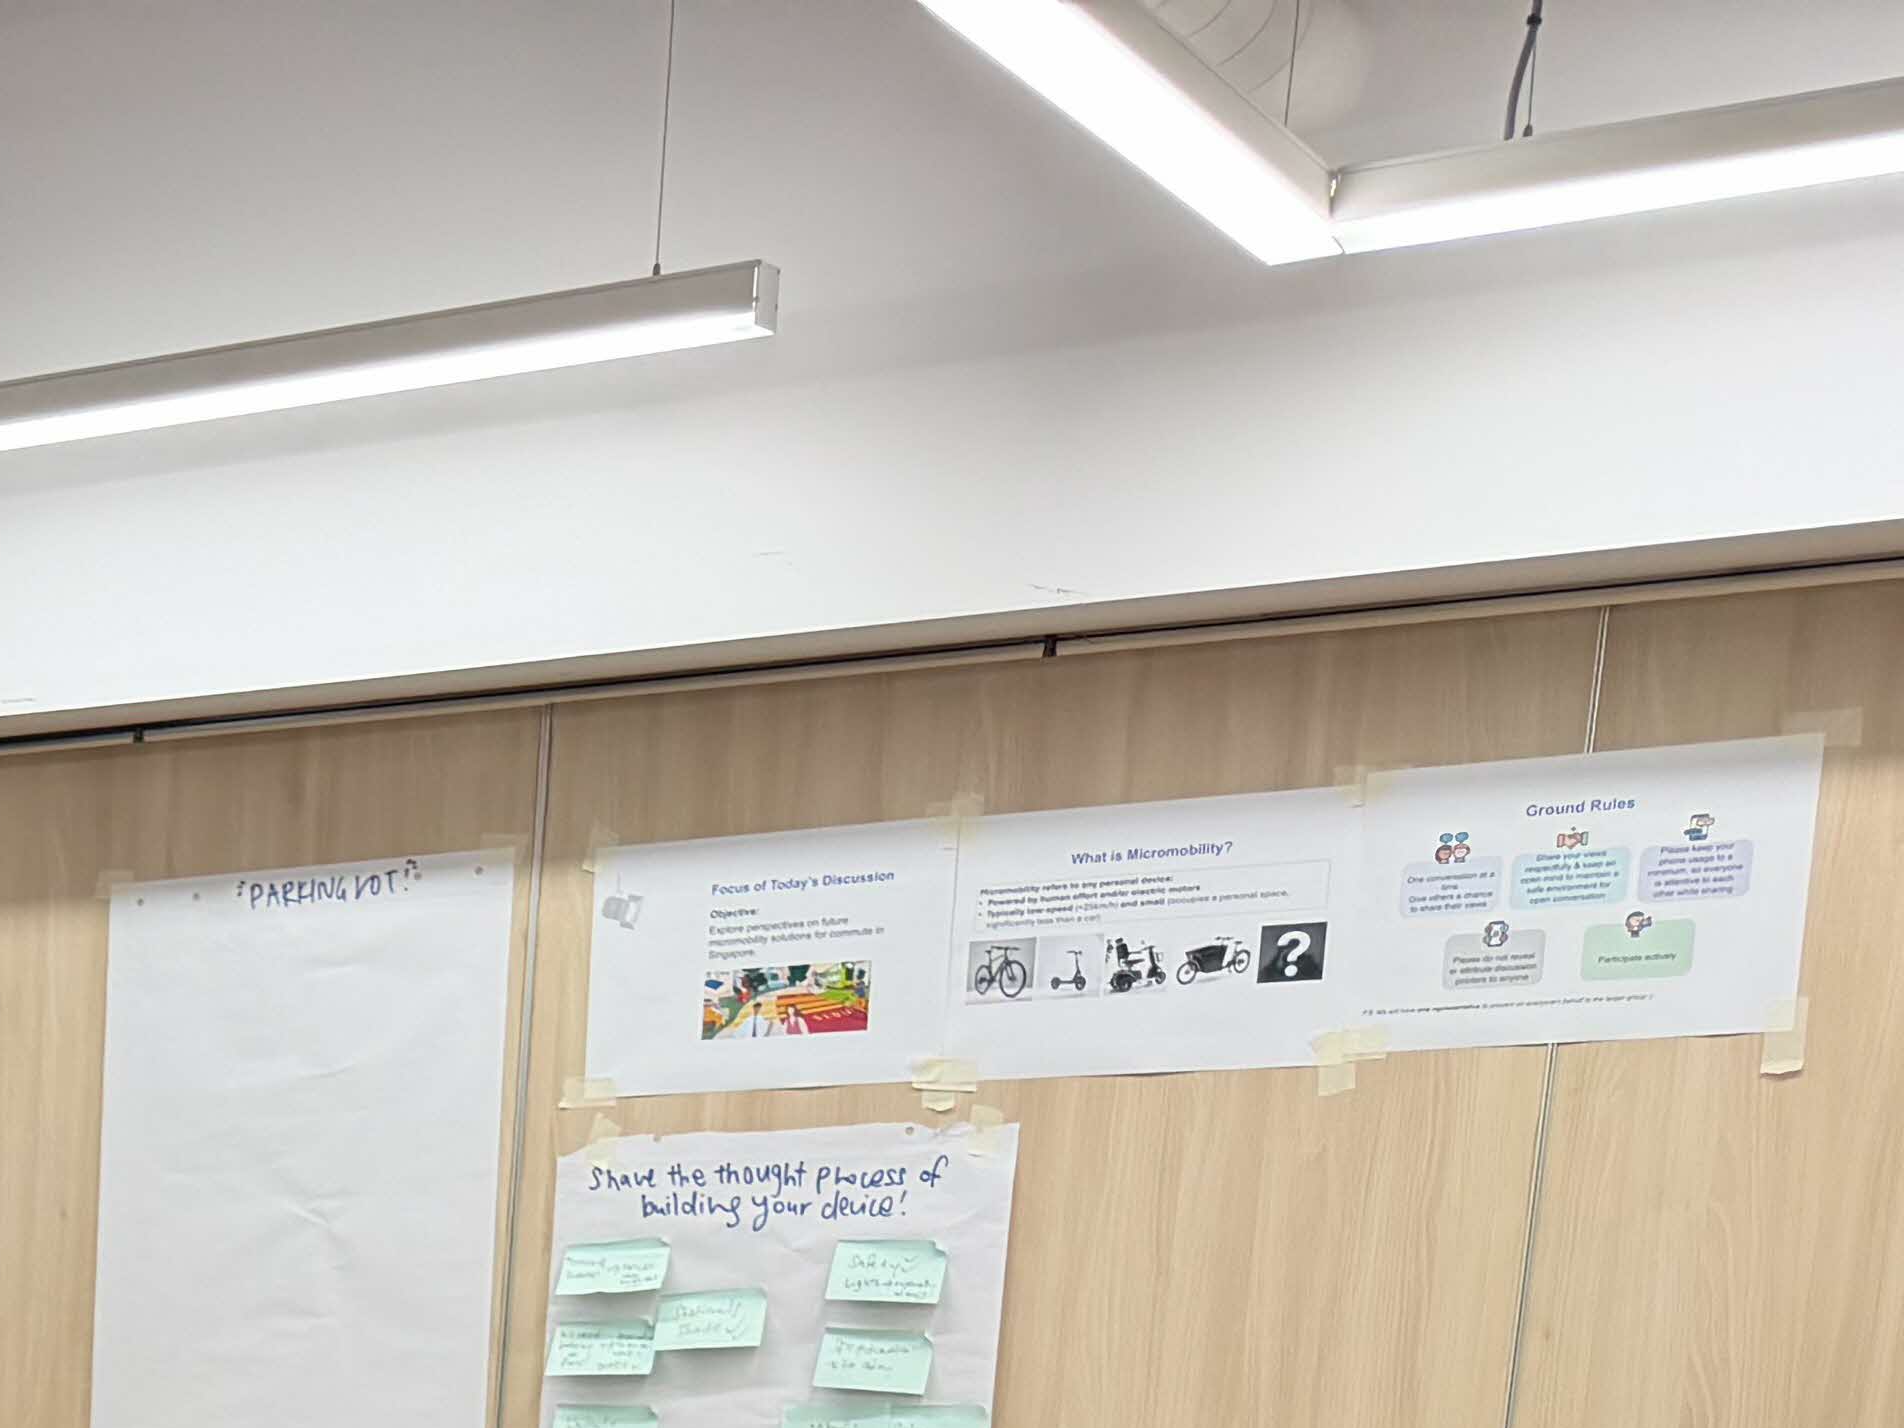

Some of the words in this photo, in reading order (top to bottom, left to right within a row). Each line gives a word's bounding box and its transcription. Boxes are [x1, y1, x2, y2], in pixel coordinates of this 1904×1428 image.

[1526, 801, 1585, 816] Ground
[1591, 798, 1635, 811] Rules
[1072, 852, 1106, 864] What
[1111, 852, 1122, 861] is
[1127, 841, 1233, 860] Micromobility?
[712, 882, 750, 896] Focus
[754, 880, 767, 891] of
[771, 877, 819, 891] Today's
[823, 871, 894, 886] Discussion
[589, 1164, 656, 1191] Share
[668, 1162, 705, 1186] the
[714, 1160, 807, 1197] thought
[816, 1165, 906, 1194] process
[920, 1155, 948, 1188] of
[641, 1192, 742, 1228] building
[752, 1194, 812, 1232] your
[821, 1189, 907, 1221] device!
